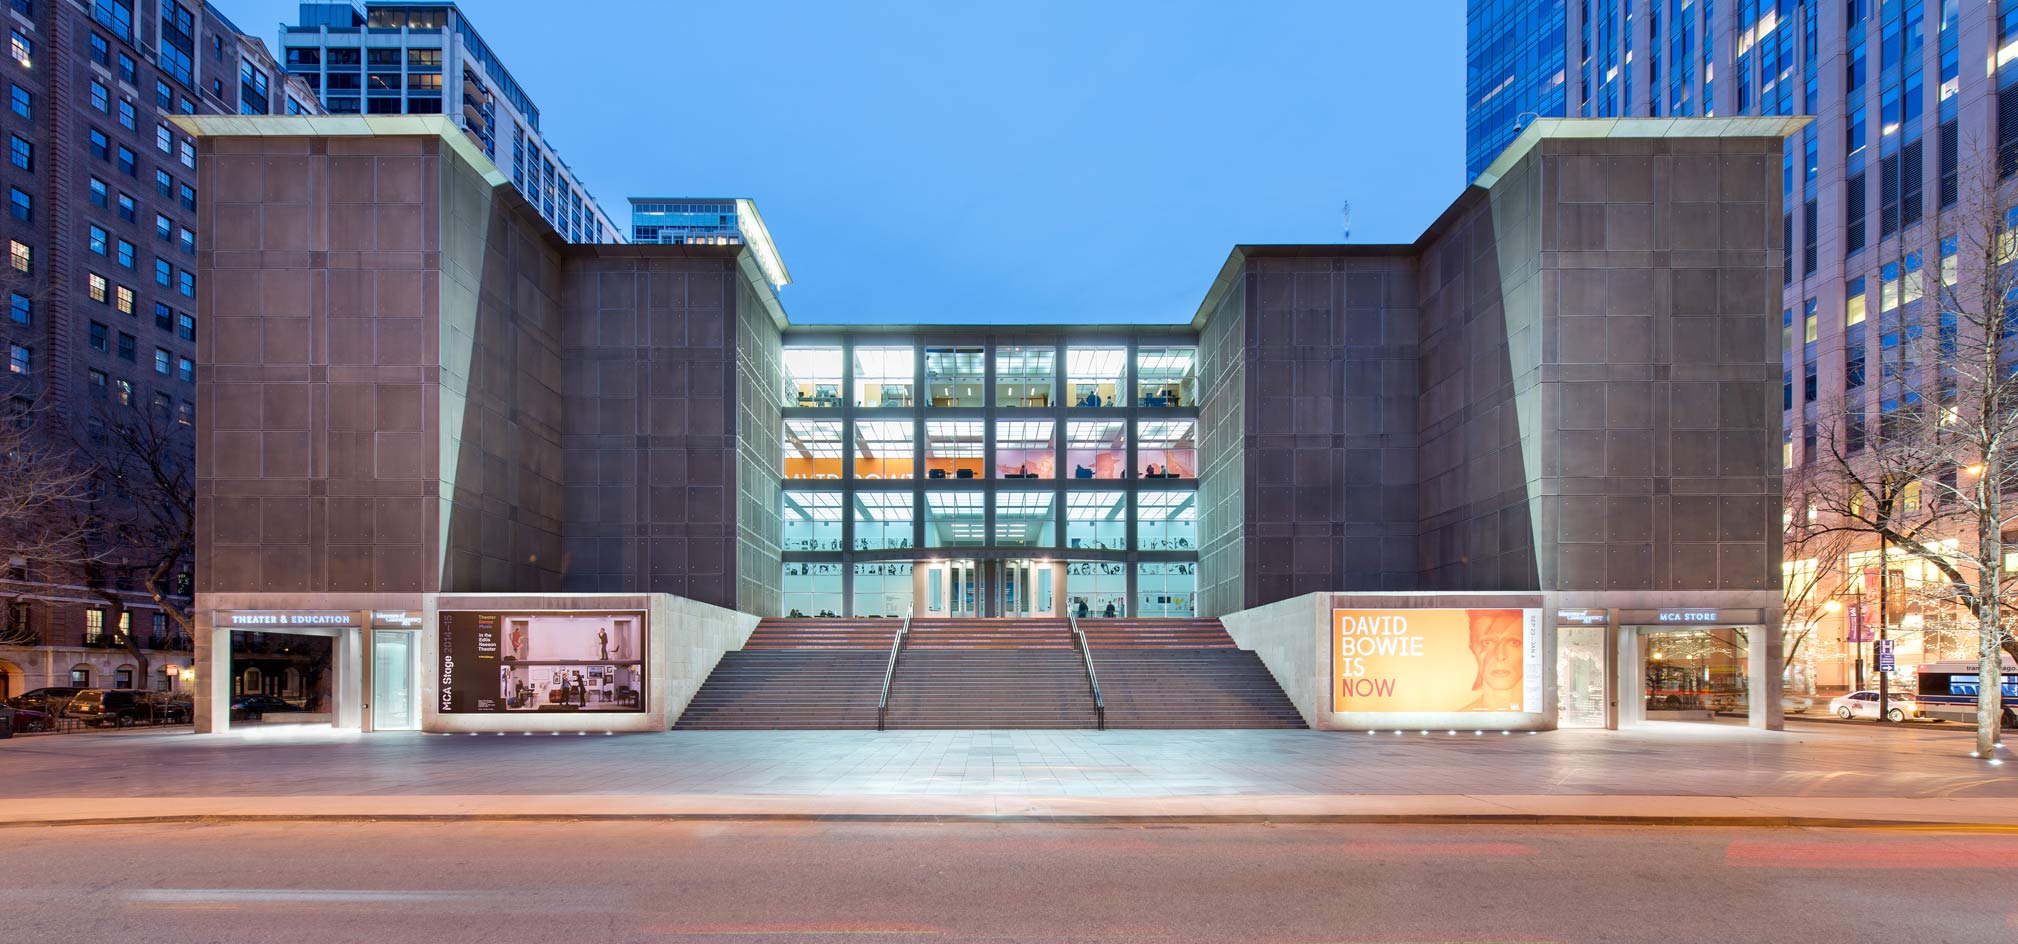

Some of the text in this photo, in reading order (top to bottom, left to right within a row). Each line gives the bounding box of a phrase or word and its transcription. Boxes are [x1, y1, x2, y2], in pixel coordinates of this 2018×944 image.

[232, 615, 351, 624] THEATER & EDUCATION
[1342, 616, 1408, 635] DAVID
[1660, 613, 1717, 621] MCA STORE
[1342, 636, 1424, 656] BOWIE
[1882, 640, 1893, 653] H
[442, 655, 455, 685] Stage
[1342, 657, 1365, 677] IS
[1342, 678, 1396, 697] NOW
[442, 686, 452, 711] MCA
